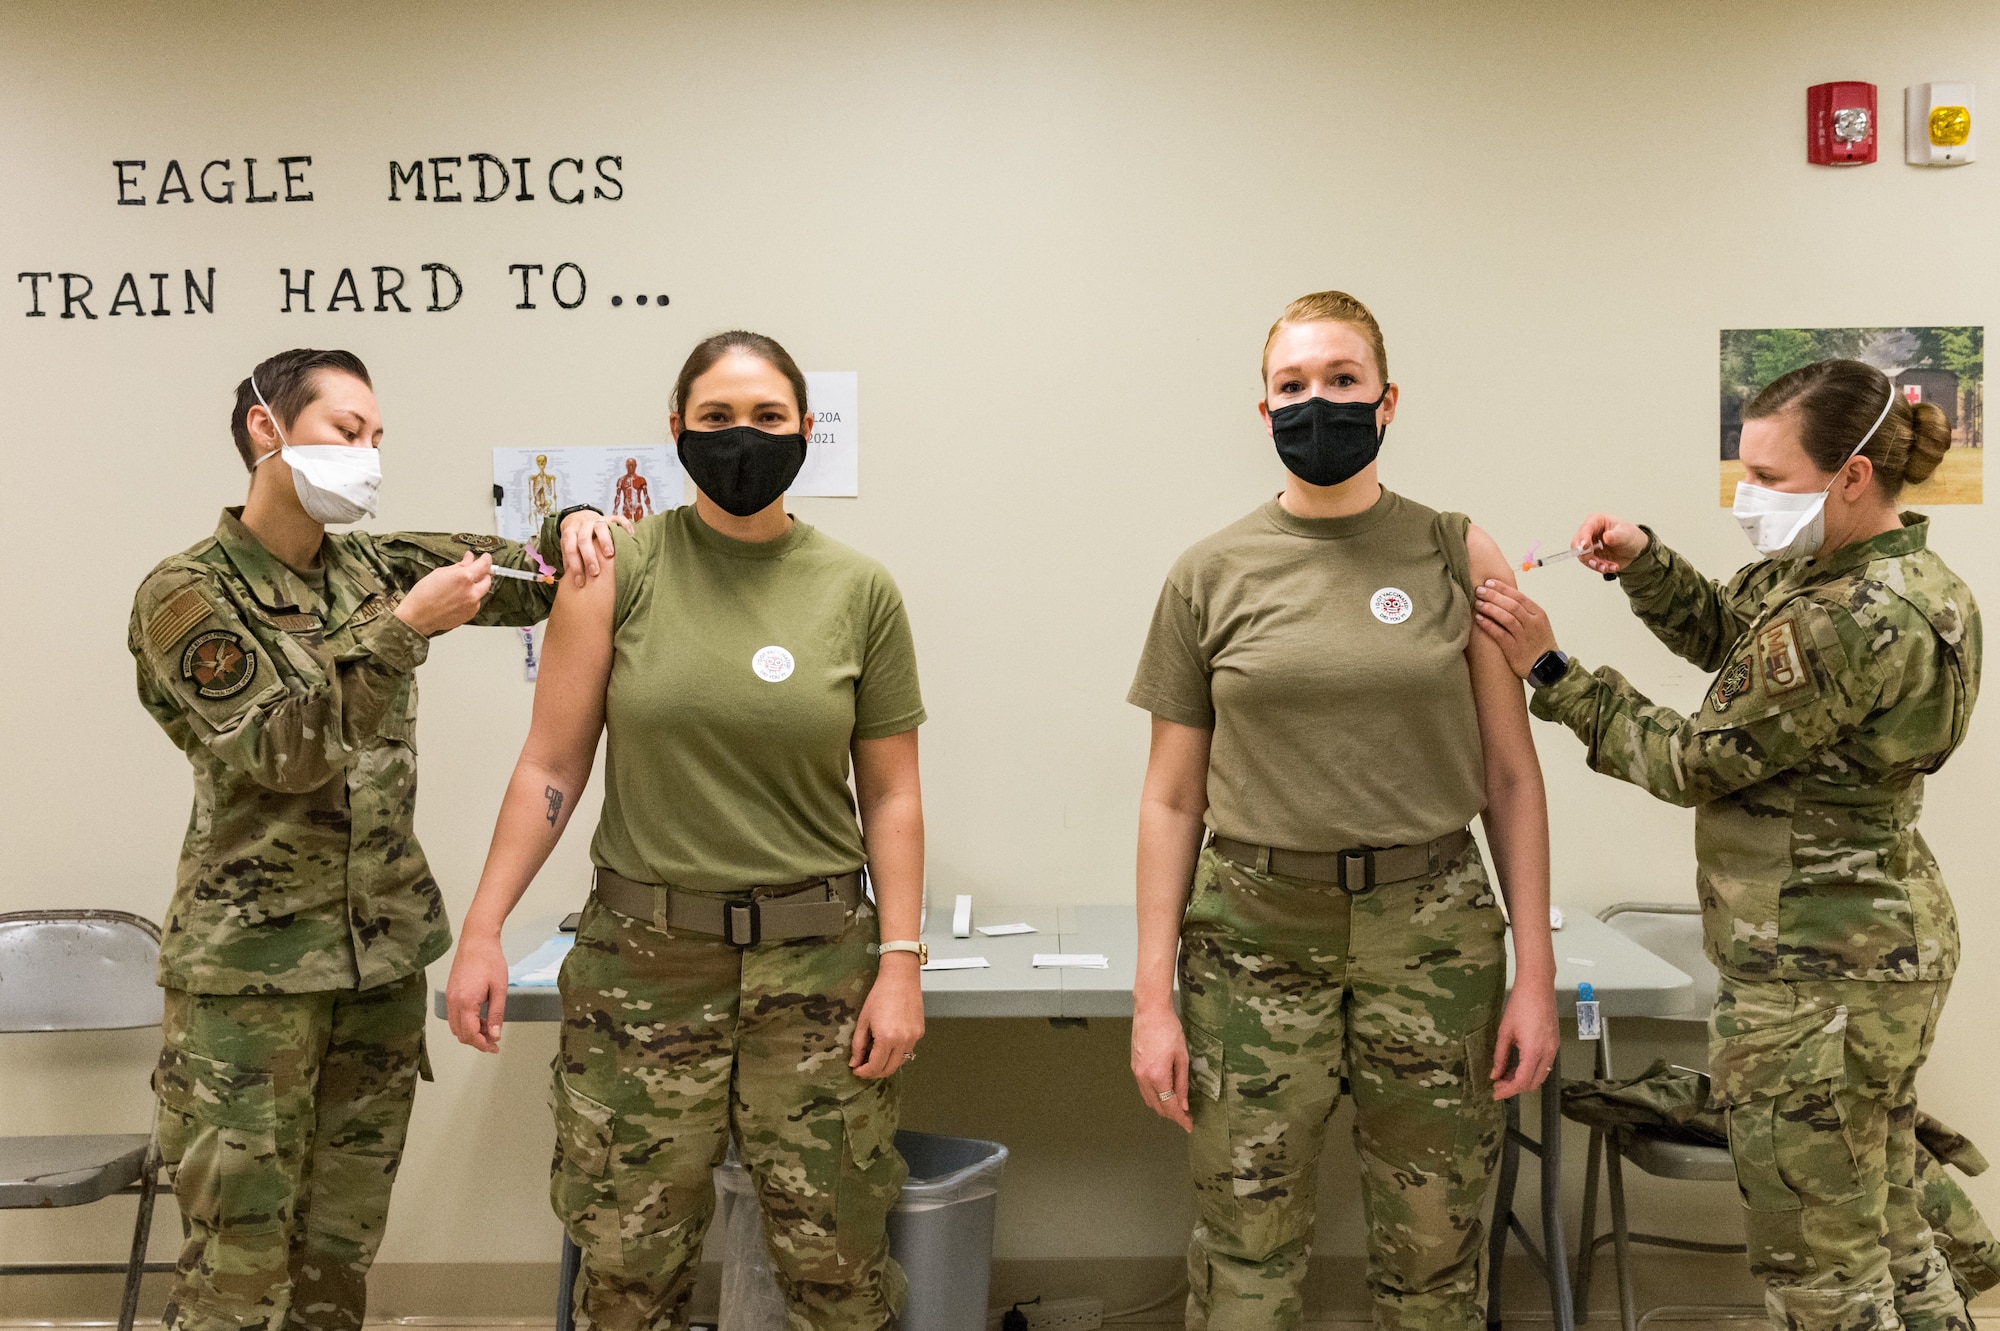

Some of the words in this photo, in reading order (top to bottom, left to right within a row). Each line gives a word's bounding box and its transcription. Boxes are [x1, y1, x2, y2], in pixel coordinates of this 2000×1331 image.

[113, 155, 314, 206] EAGLE
[388, 152, 625, 205] MEDICS
[18, 267, 217, 320] TRAIN
[280, 262, 463, 313] HARD
[508, 262, 671, 310] TO...
[361, 600, 382, 620] AIR
[1767, 629, 1795, 685] MED
